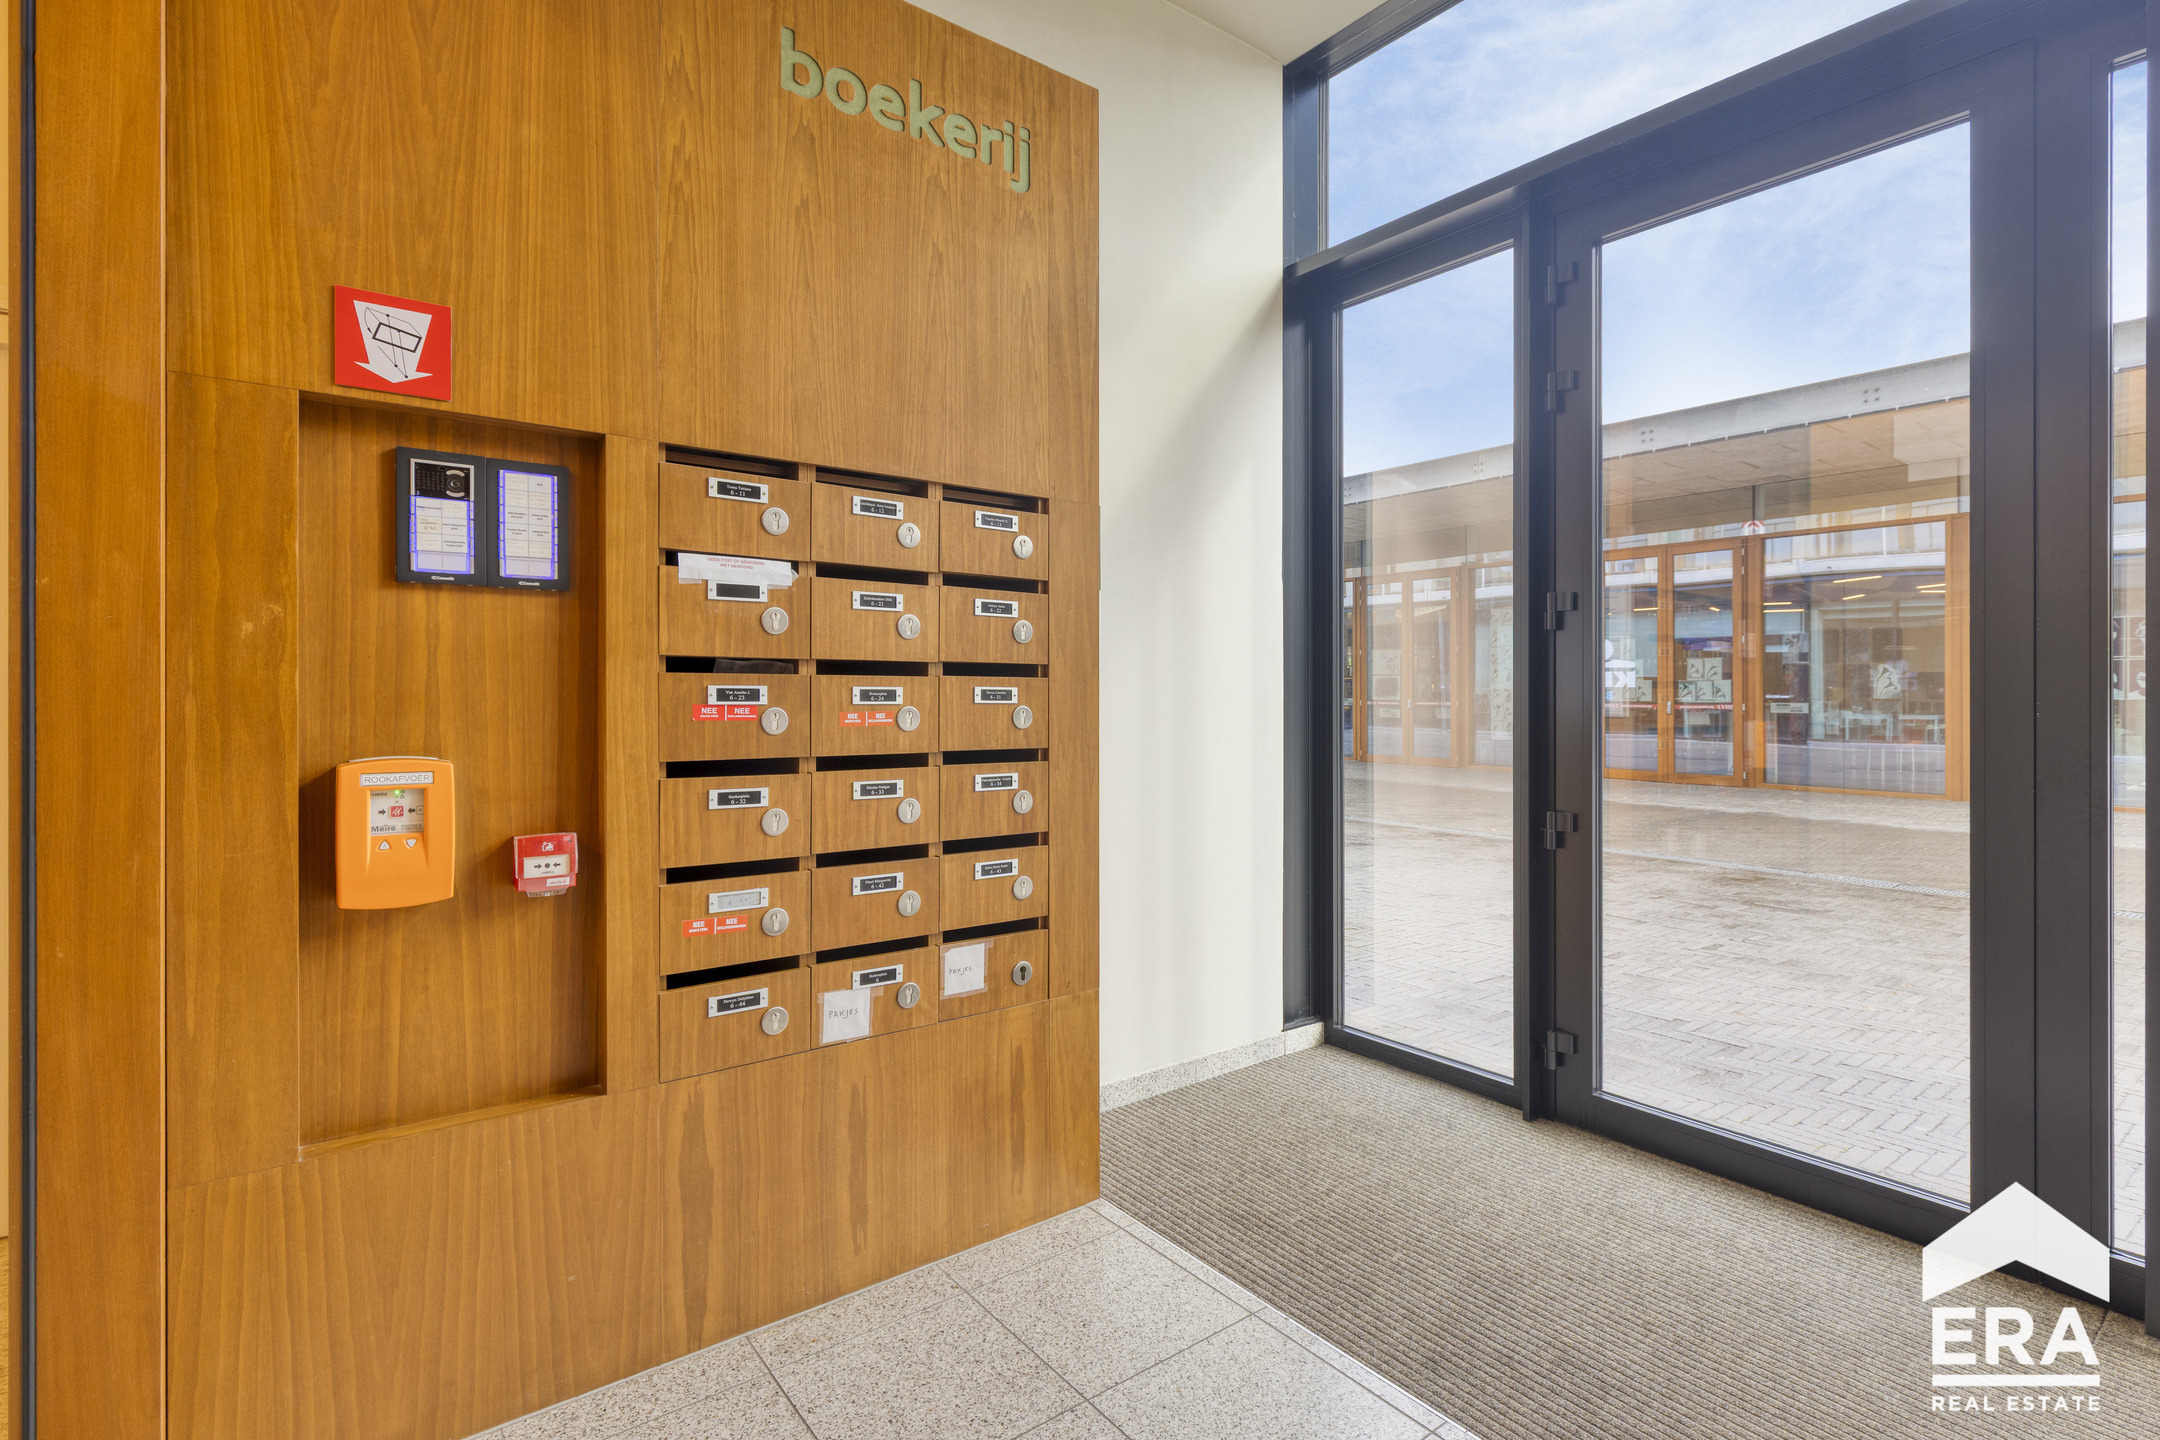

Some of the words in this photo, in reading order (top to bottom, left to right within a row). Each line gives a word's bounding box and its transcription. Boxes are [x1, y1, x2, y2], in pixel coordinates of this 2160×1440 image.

[781, 26, 1030, 193] boekerij
[364, 774, 430, 783] ROOKAFVOER
[949, 966, 972, 975] PAKJES
[828, 1008, 858, 1019] PAKJES
